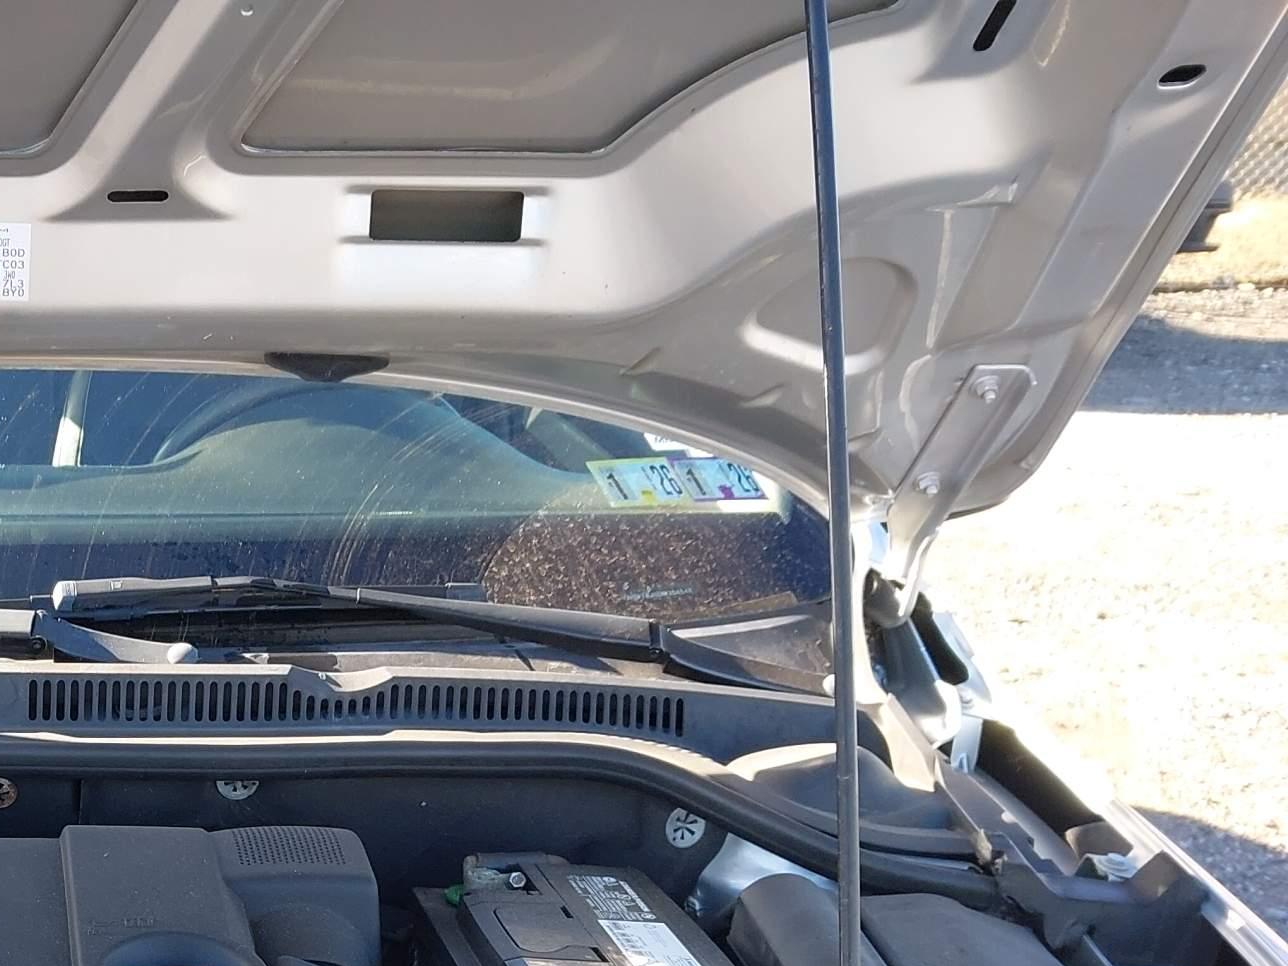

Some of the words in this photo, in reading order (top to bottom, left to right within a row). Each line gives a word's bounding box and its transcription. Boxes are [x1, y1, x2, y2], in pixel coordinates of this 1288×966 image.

[606, 473, 628, 500] 1
[650, 465, 683, 495] 26
[686, 468, 706, 495] 1
